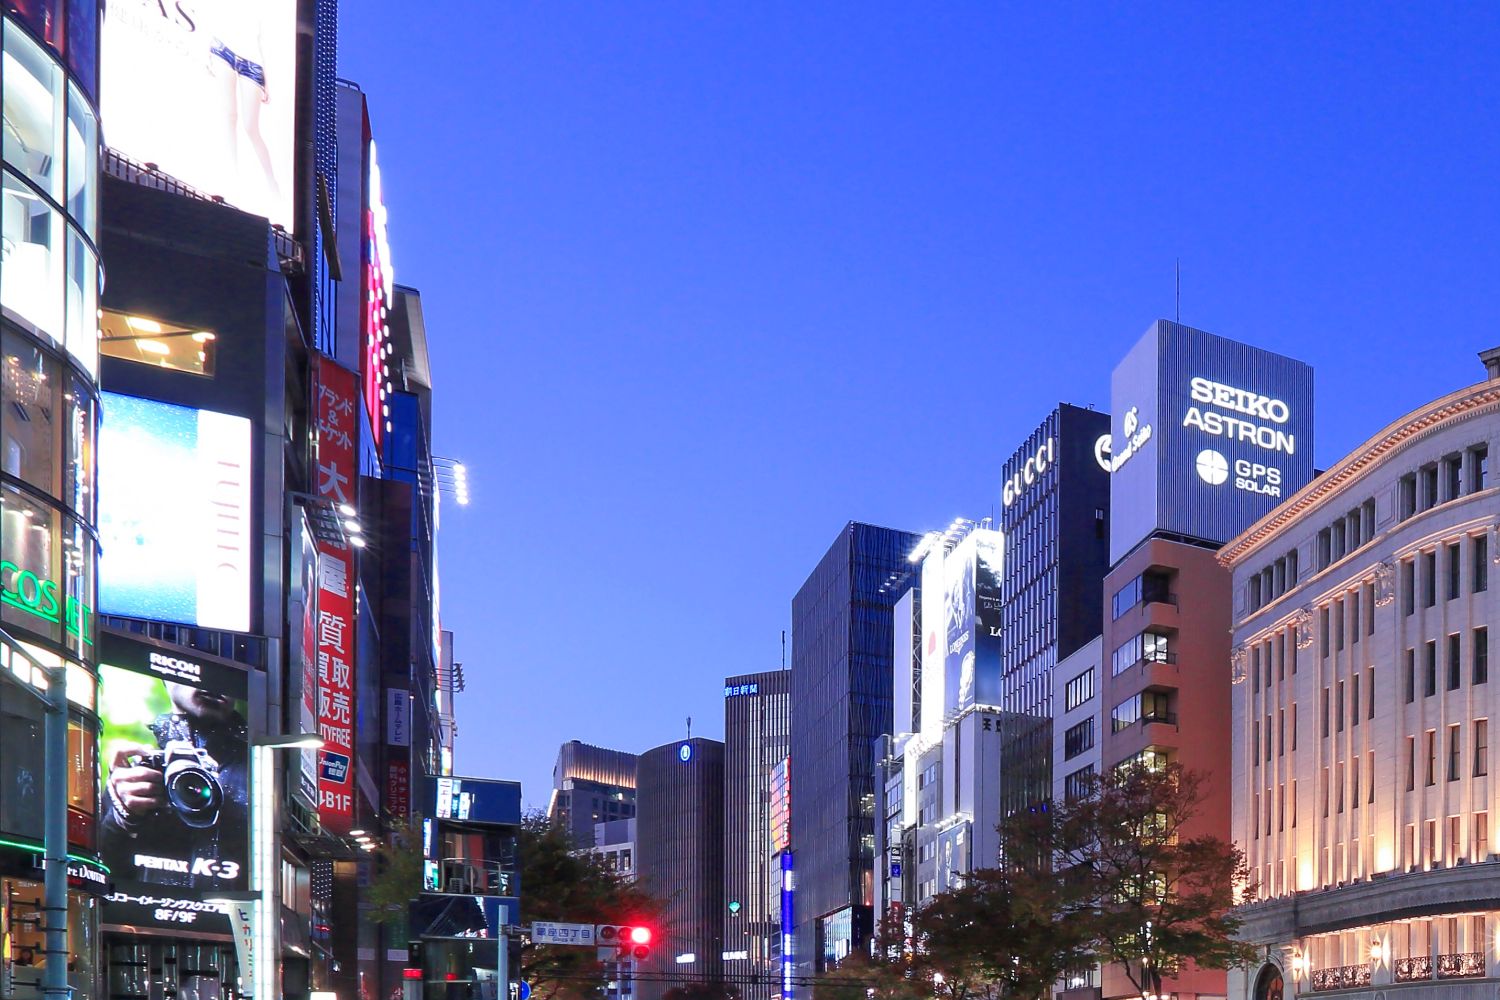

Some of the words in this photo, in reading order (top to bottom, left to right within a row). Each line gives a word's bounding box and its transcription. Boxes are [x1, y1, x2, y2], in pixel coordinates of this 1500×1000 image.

[1191, 377, 1289, 423] SEIKO
[328, 411, 339, 426] &
[1183, 407, 1294, 454] ASTRON
[1003, 438, 1053, 507] GUCCI
[1235, 459, 1281, 485] GPS
[1235, 477, 1280, 498] SOLAR
[319, 611, 346, 654] 質
[150, 653, 200, 675] RICOH
[724, 684, 758, 697] 朝日新聞
[134, 854, 189, 873] PENTAX
[191, 858, 240, 879] K-3
[155, 909, 197, 923] 8F/9F
[536, 927, 590, 939] 銀座四丁目
